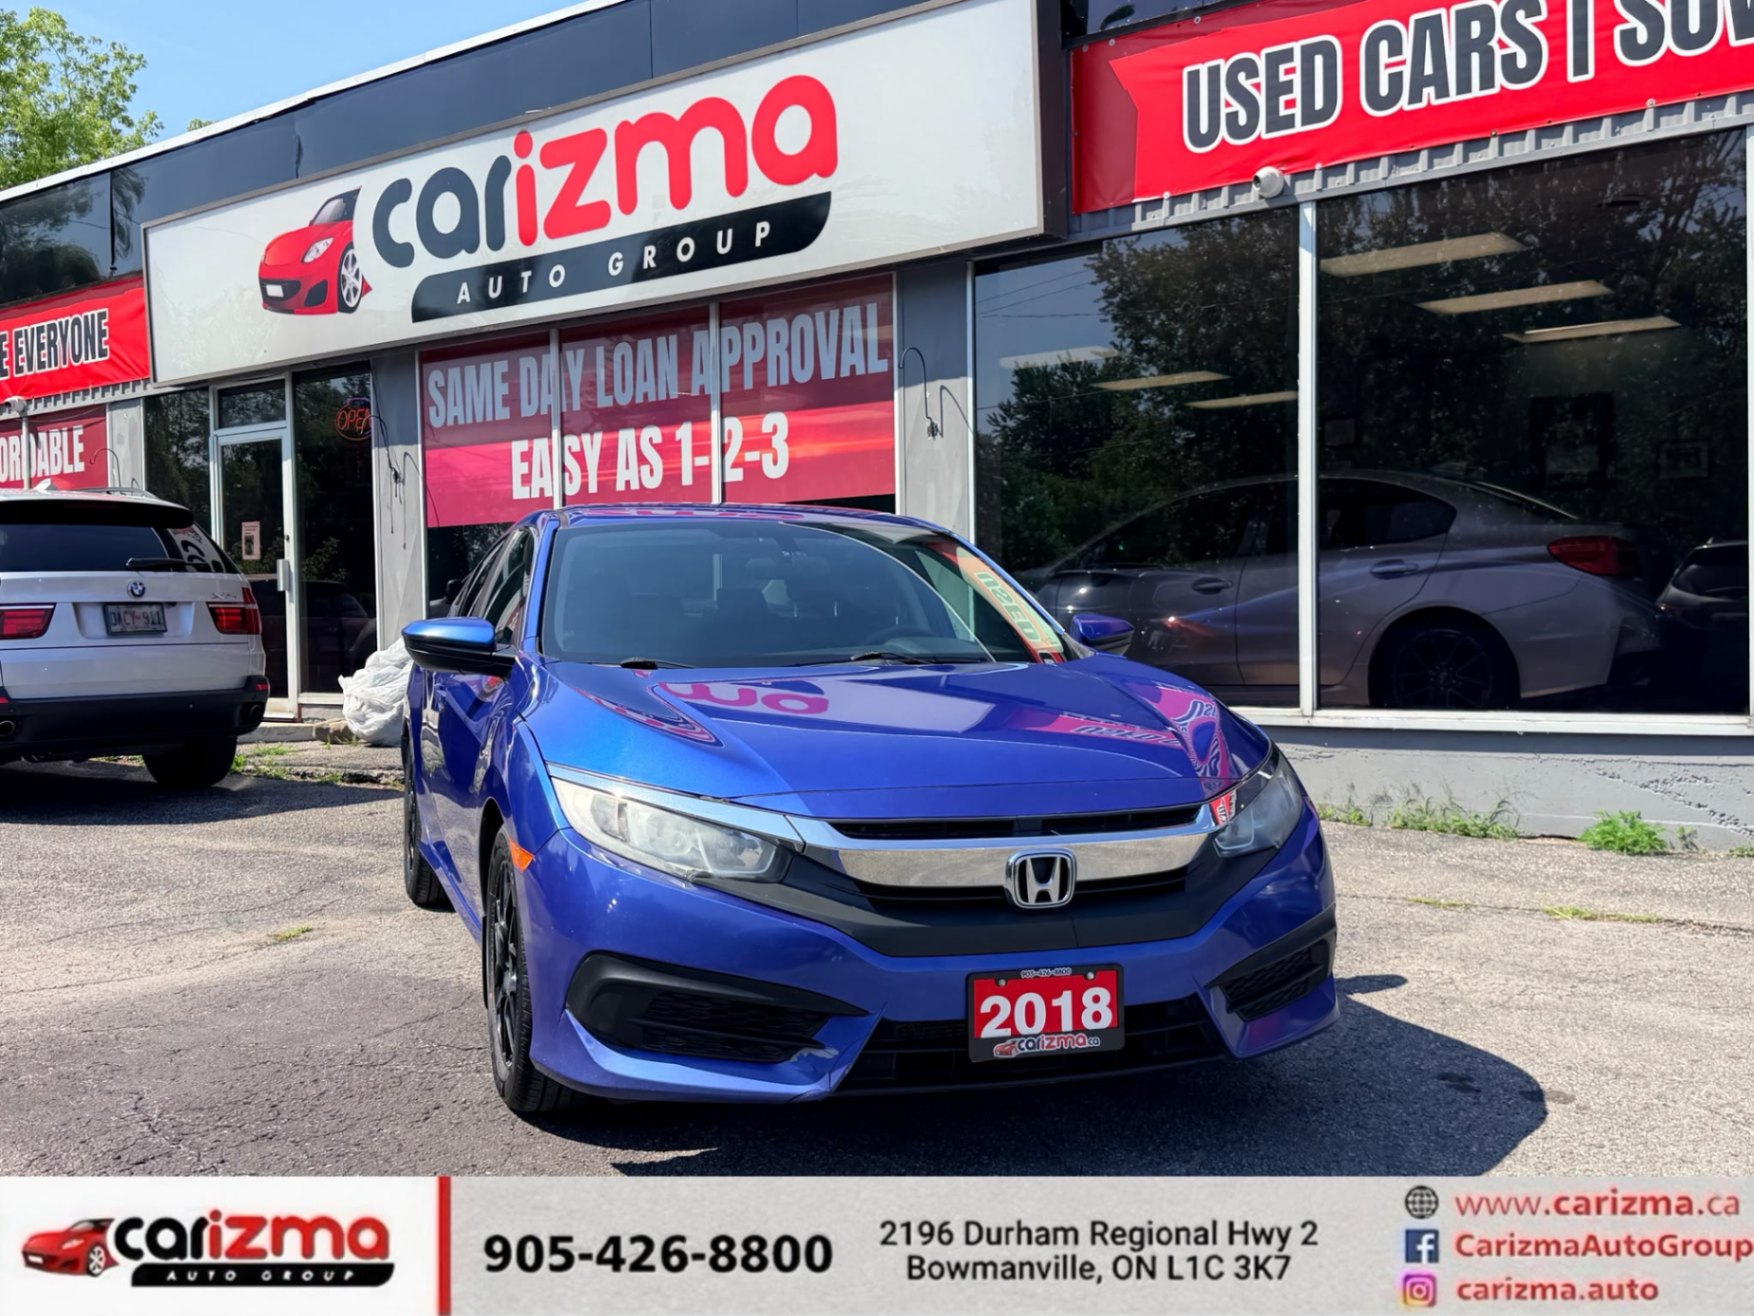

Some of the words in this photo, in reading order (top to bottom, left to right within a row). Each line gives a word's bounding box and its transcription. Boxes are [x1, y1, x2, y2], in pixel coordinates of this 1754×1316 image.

[1184, 35, 1341, 152] USED
[1361, 0, 1549, 116] CARS
[372, 75, 838, 268] carizma
[457, 265, 565, 304] AUTO
[608, 221, 770, 276] GROUP
[14, 309, 108, 377] EVERYONE
[428, 360, 510, 428] SAME
[519, 349, 584, 418] DAY
[597, 334, 678, 408] LOAN
[691, 303, 888, 396] APPROVAL
[512, 432, 603, 499] EASY
[616, 425, 663, 491] AS
[676, 411, 789, 486] 1-2-3
[980, 987, 1112, 1038] 2018
